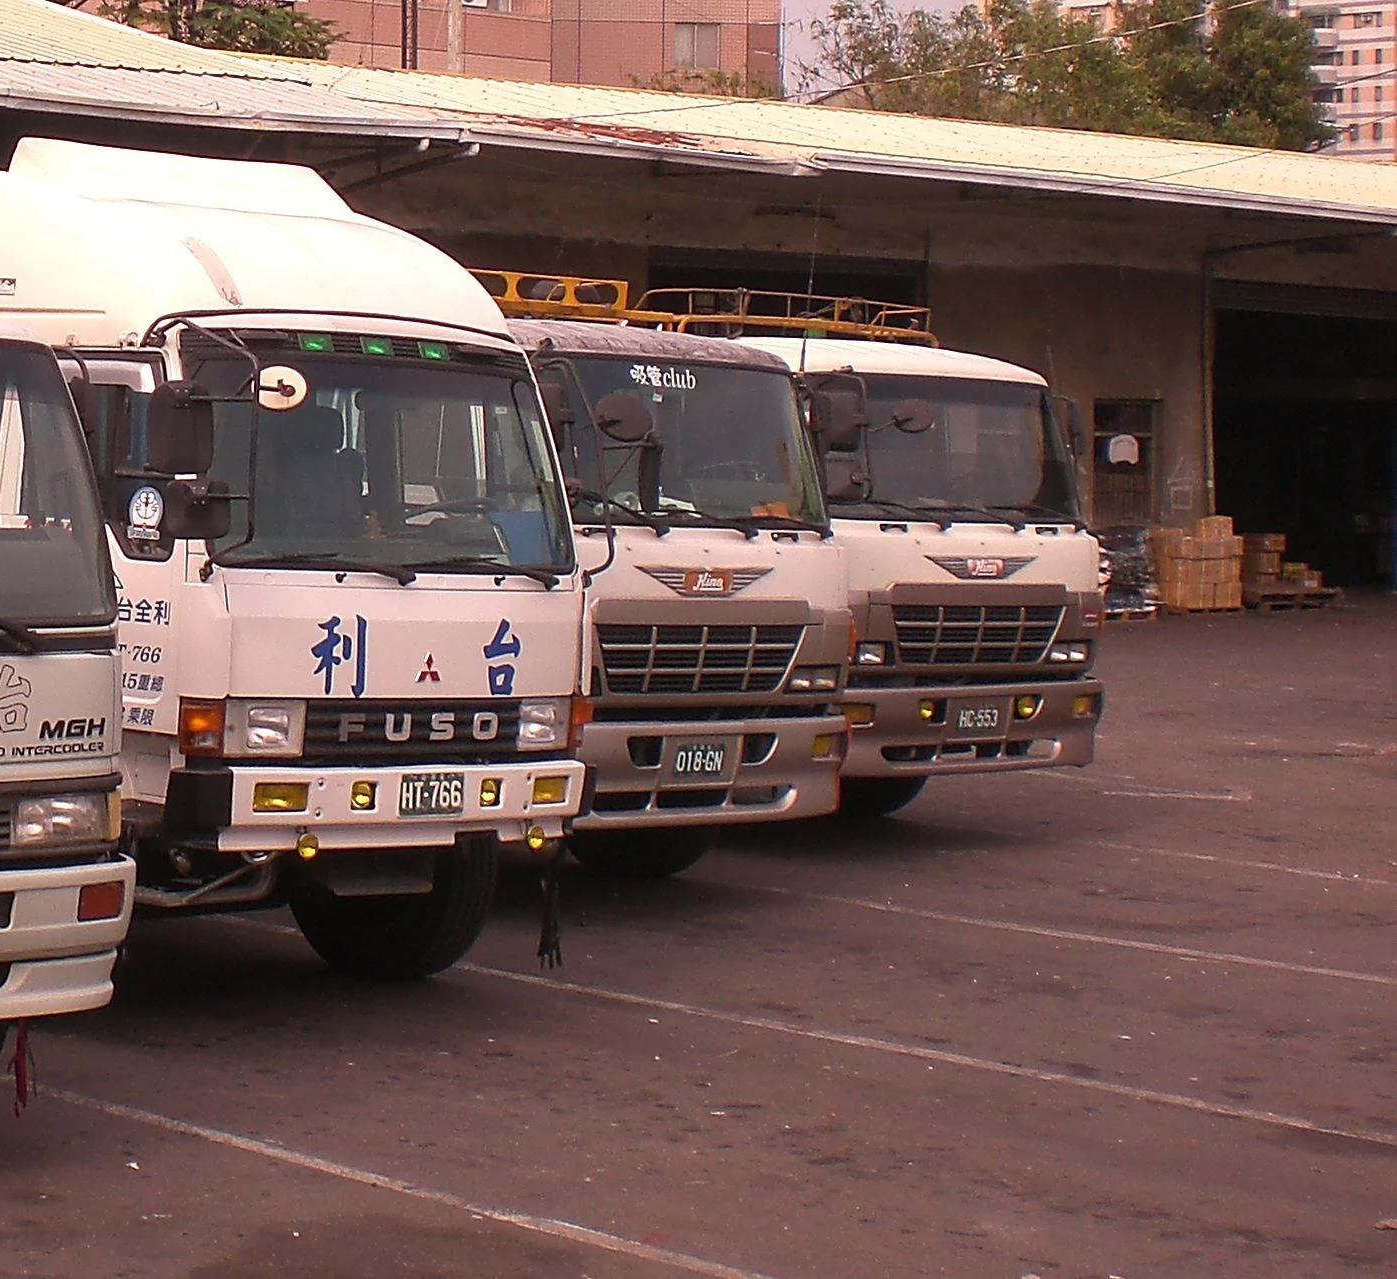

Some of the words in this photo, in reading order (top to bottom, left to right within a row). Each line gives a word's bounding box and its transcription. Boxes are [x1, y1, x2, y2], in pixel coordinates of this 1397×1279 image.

[692, 572, 724, 591] Hino
[311, 615, 367, 698] 利
[483, 619, 521, 696] 台
[39, 717, 106, 739] MGH
[338, 711, 500, 743] FUSO
[959, 708, 999, 728] HC-553
[11, 741, 104, 757] INTERCOOLER
[676, 750, 724, 772] 018-GN
[401, 780, 462, 809] HT-766
